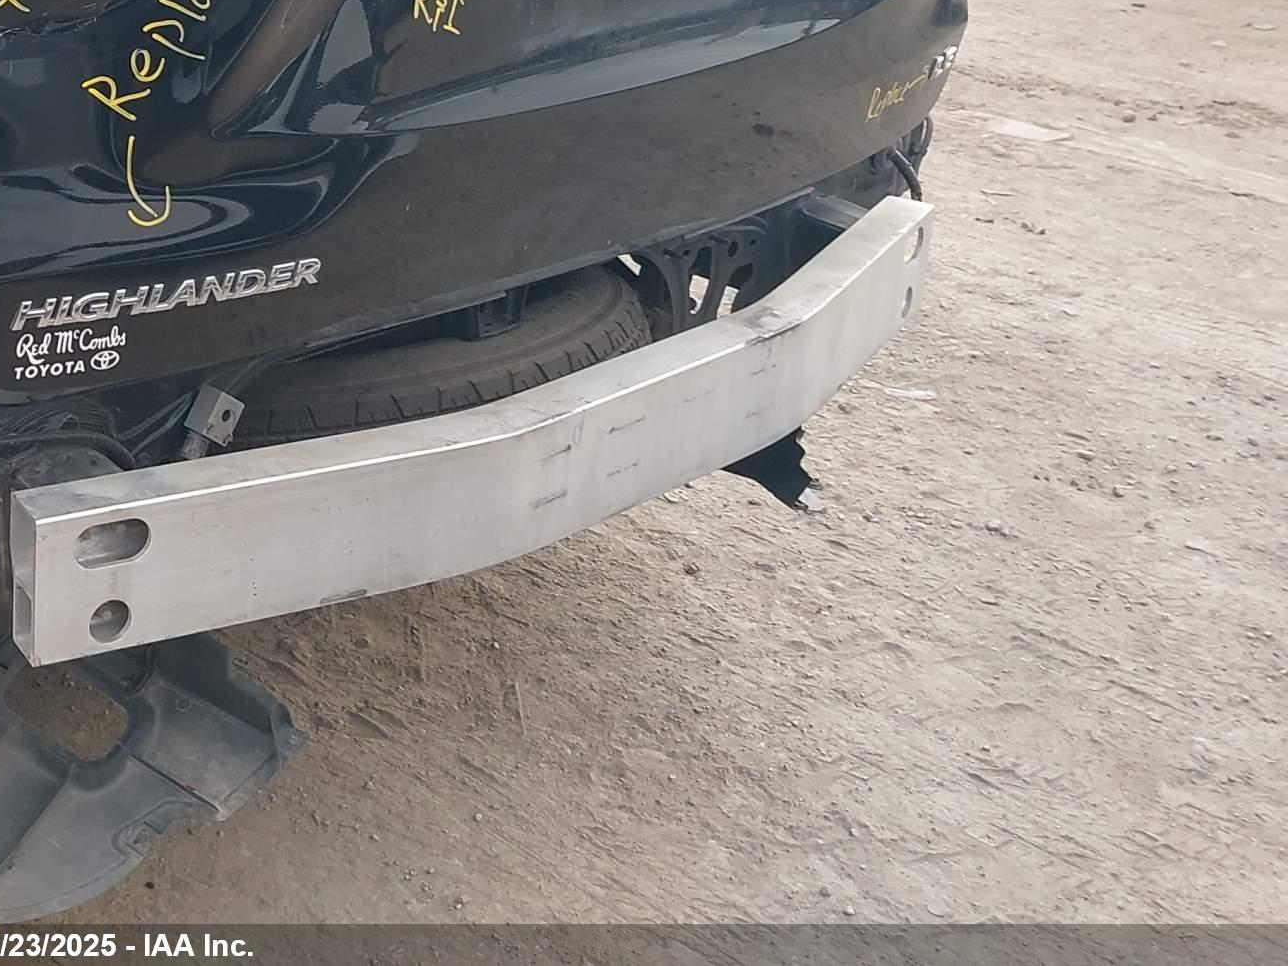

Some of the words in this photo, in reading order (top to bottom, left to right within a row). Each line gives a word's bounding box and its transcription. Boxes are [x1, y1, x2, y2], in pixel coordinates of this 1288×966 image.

[9, 258, 321, 332] HIGHLANDER
[16, 333, 52, 364] Red
[14, 359, 86, 380] TOYOTA
